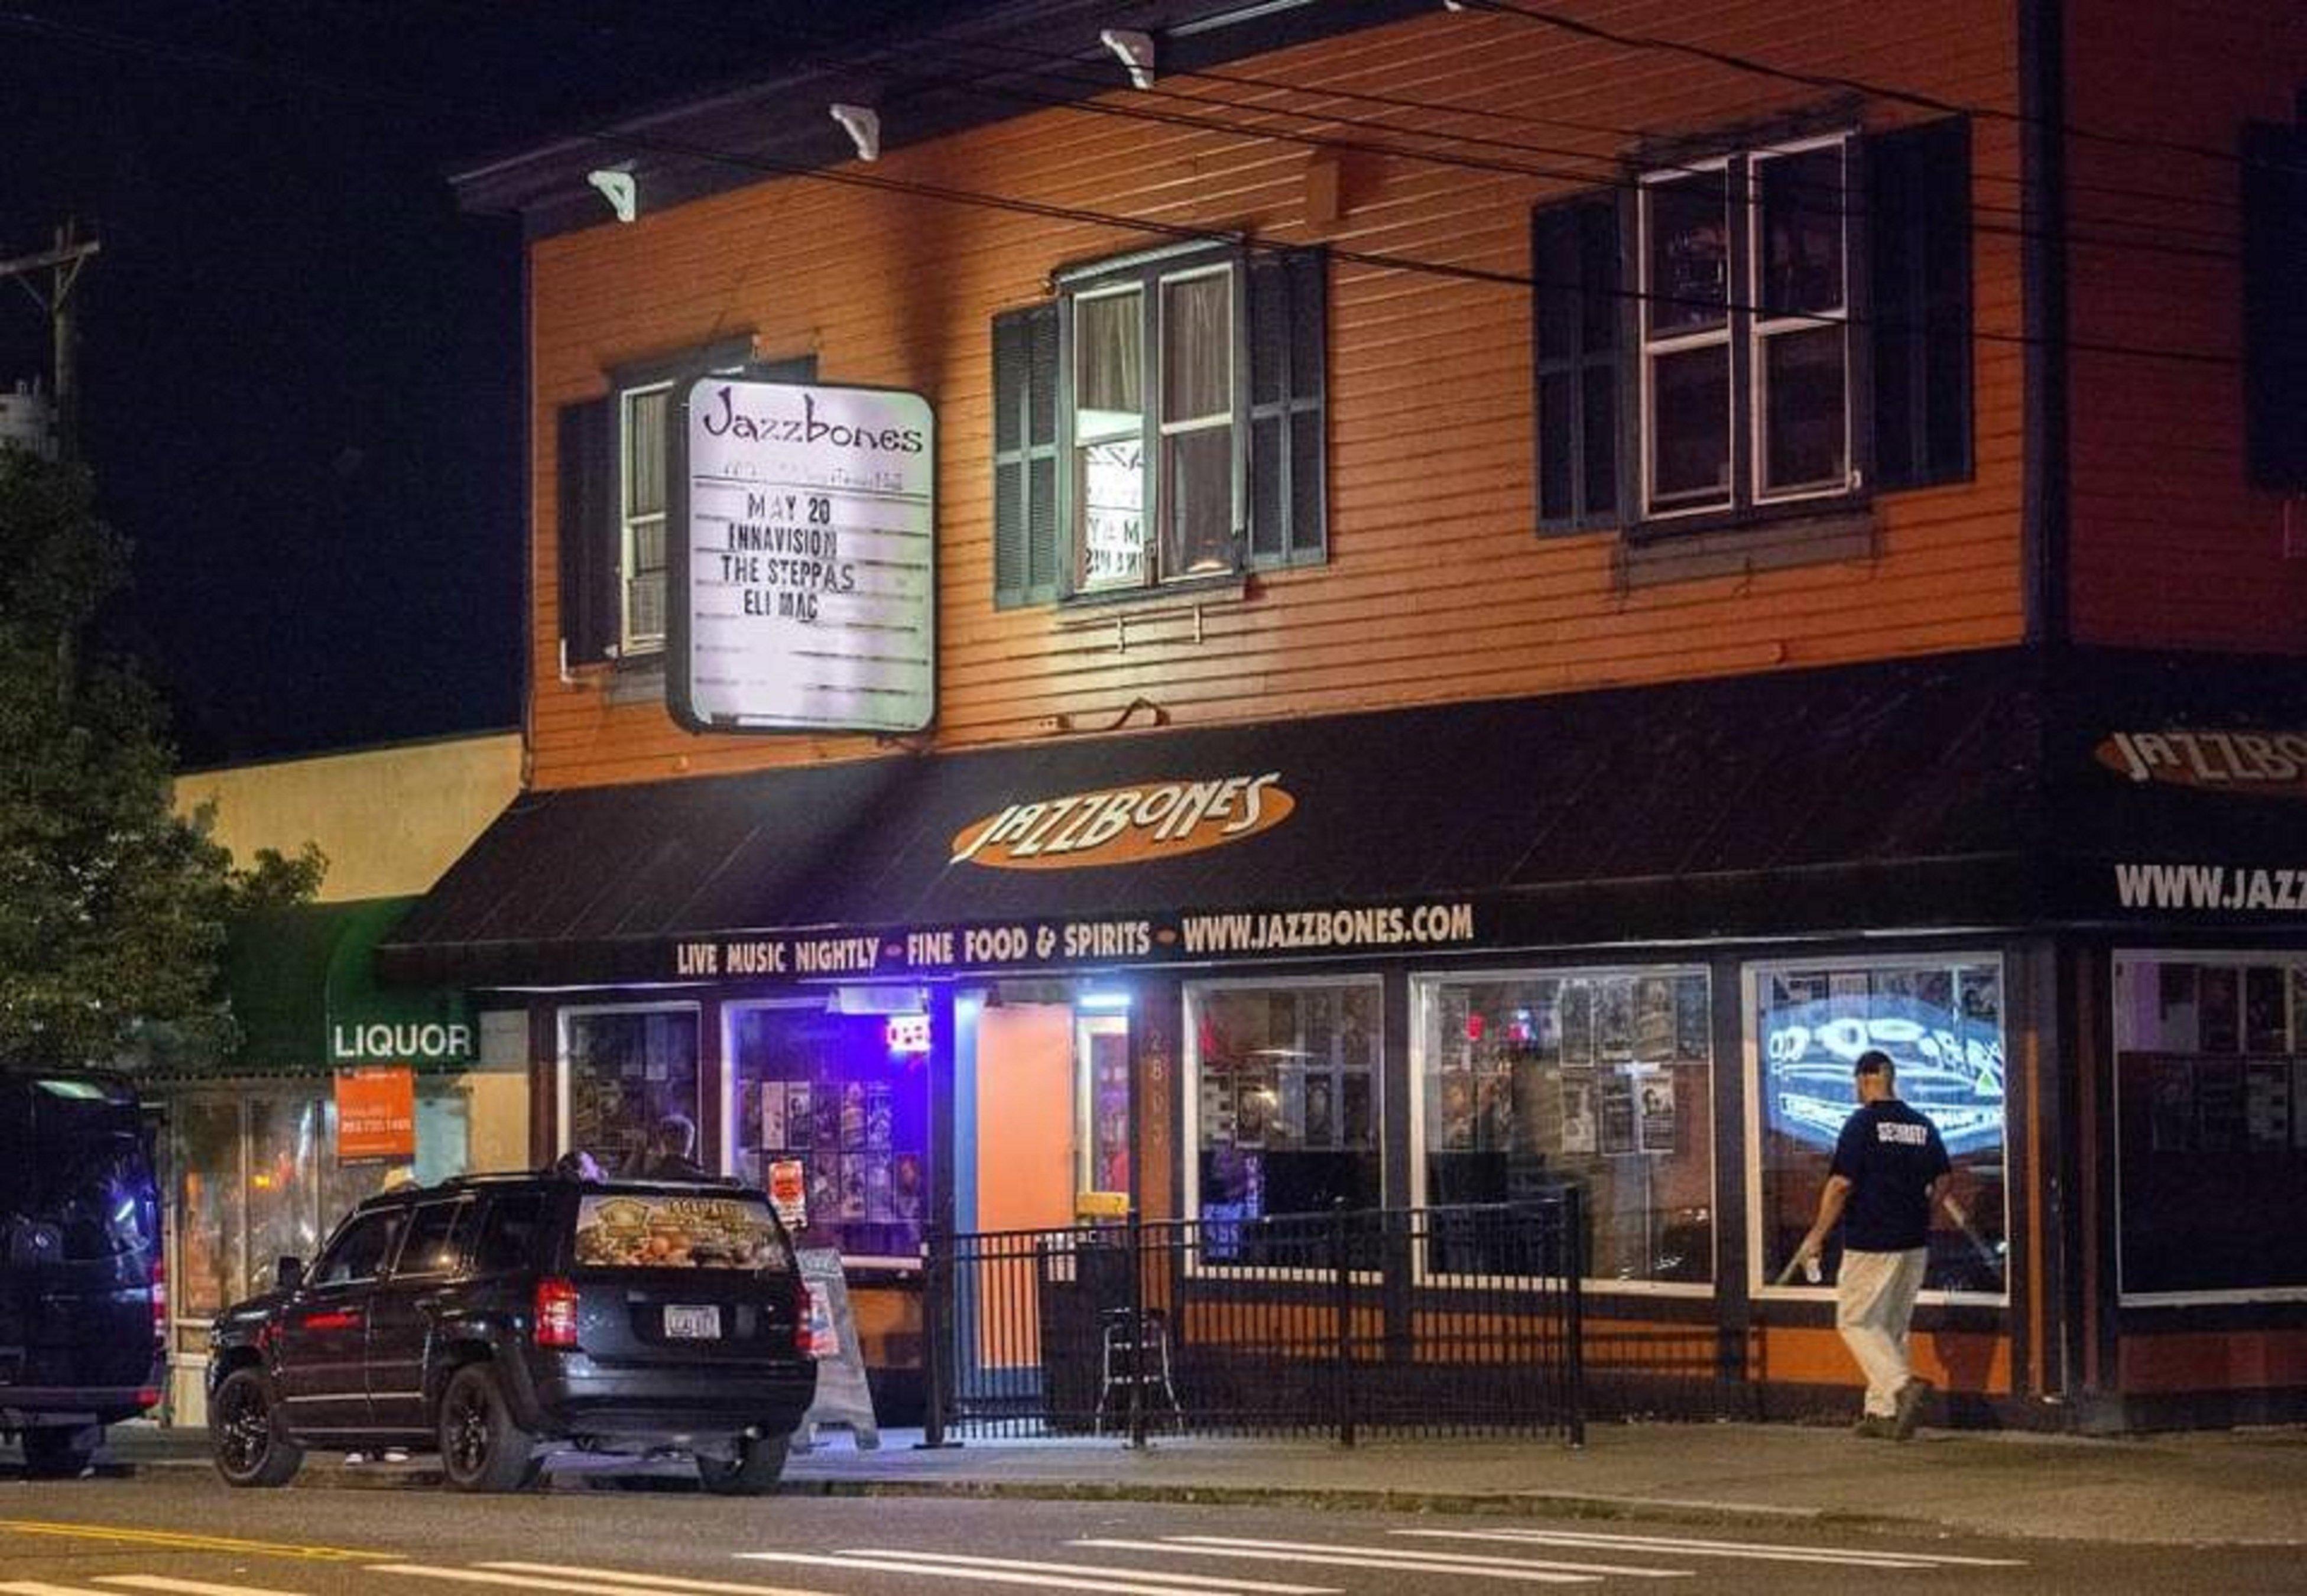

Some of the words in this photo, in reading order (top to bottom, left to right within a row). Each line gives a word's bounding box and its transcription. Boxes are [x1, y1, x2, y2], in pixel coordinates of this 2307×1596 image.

[704, 386, 924, 454] Jazzbones
[747, 491, 797, 521] MAY
[808, 497, 831, 525] 20
[721, 554, 760, 583] THE
[768, 558, 855, 591] STEPPAS
[743, 589, 771, 616] ELI
[778, 591, 818, 621] MAC
[950, 772, 1281, 865] JAZZBONES
[677, 944, 718, 975] LIVE
[726, 942, 786, 973] MUSIC
[795, 938, 879, 971] NIGHTLY
[907, 933, 955, 965] FINE
[965, 929, 1028, 963] FOOD
[1036, 926, 1057, 958] &
[1064, 921, 1151, 957] SPIRITS
[1183, 904, 1473, 953] WWW.JAZZBONES.COM
[335, 1023, 473, 1057] LIQUOR
